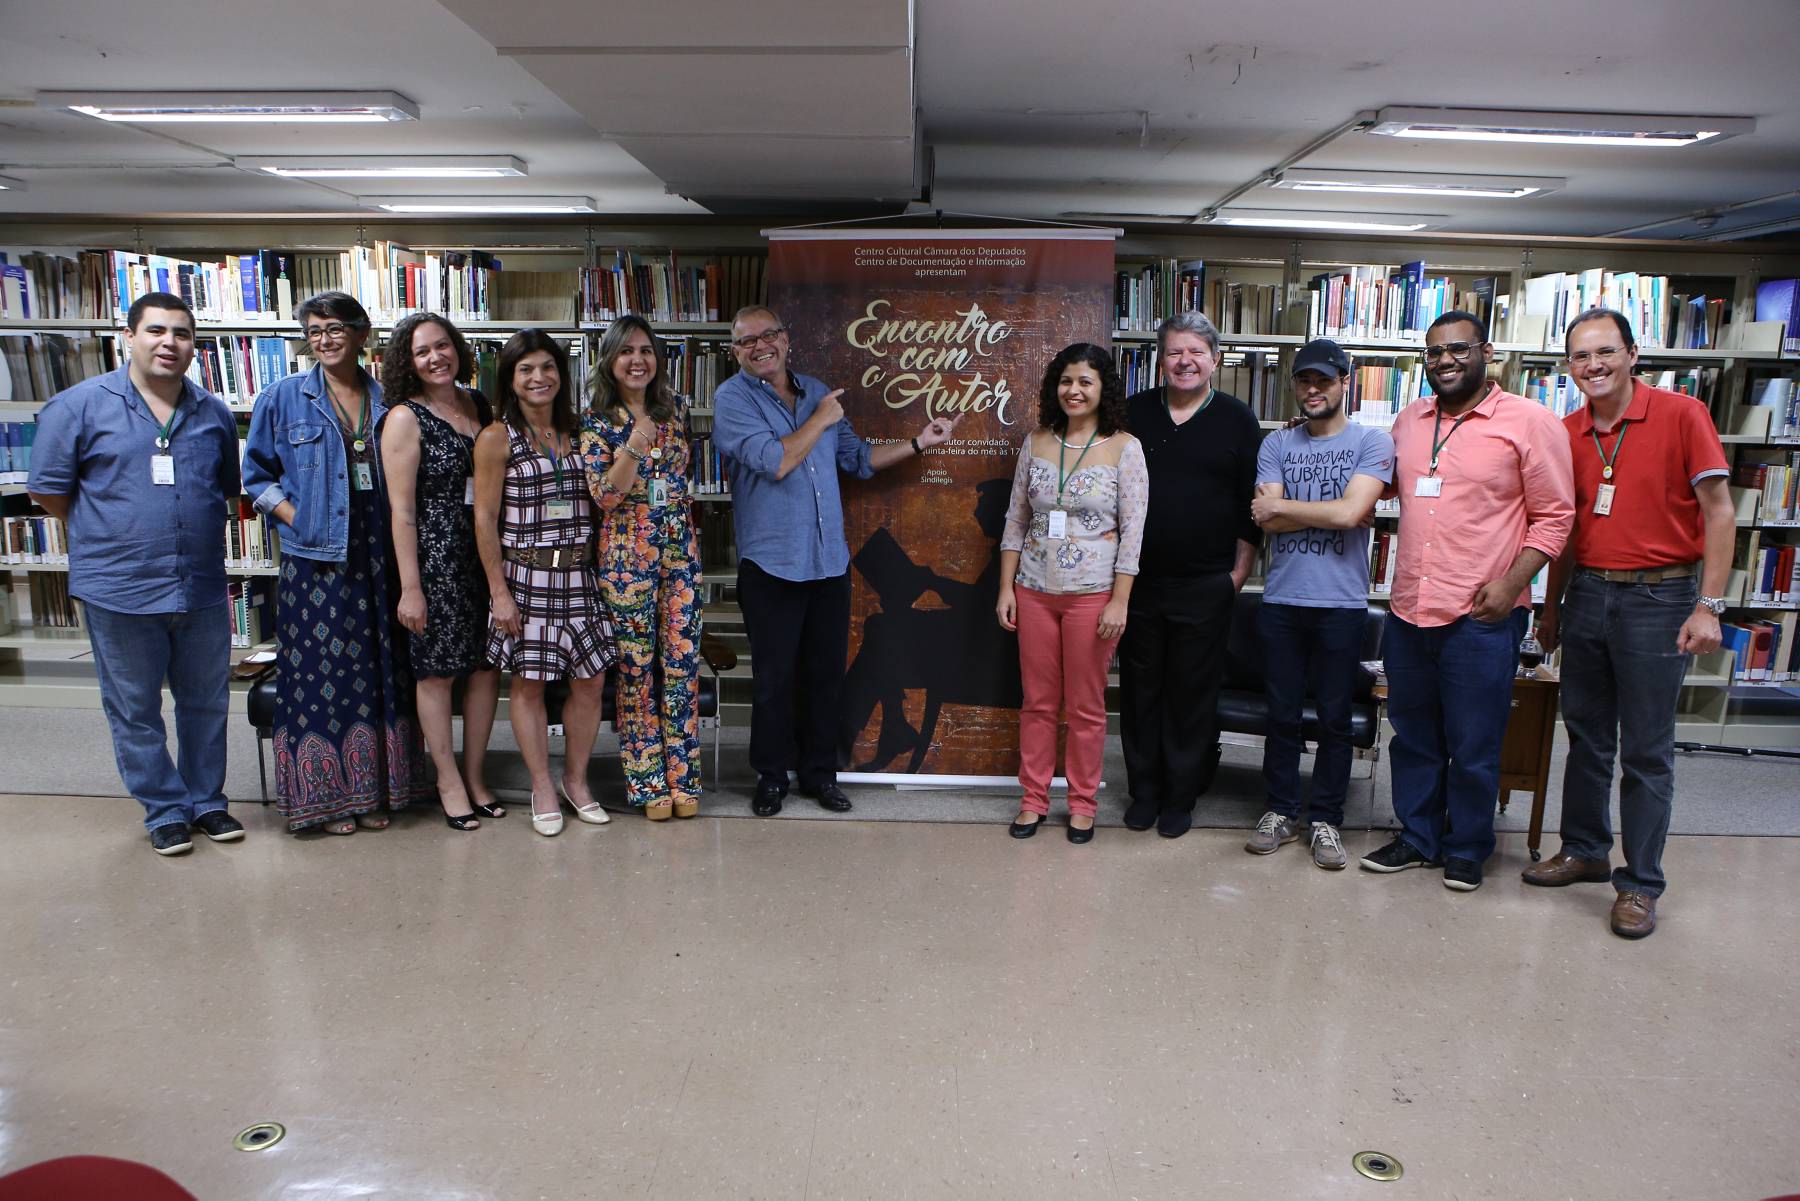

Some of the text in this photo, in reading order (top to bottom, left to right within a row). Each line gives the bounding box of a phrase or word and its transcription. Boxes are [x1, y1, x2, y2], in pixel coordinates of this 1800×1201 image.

[854, 246, 1026, 258] Centro Cultural Câmara dos Deputados
[854, 257, 885, 266] Centro
[886, 257, 898, 266] de
[900, 257, 966, 268] Documentação
[976, 257, 1026, 268] Informação
[915, 268, 967, 278] apresentam
[846, 299, 1012, 358] Encontro
[899, 346, 974, 372] com
[861, 364, 1015, 426] o Autor
[967, 438, 1010, 446] convidado
[967, 447, 979, 455] do
[980, 447, 997, 456] mês
[999, 447, 1008, 456] às
[1284, 450, 1354, 465] ALMODÓVAR
[927, 468, 947, 477] Apoio
[1282, 464, 1352, 484] KUBRICK
[921, 476, 953, 486] Sindilegis
